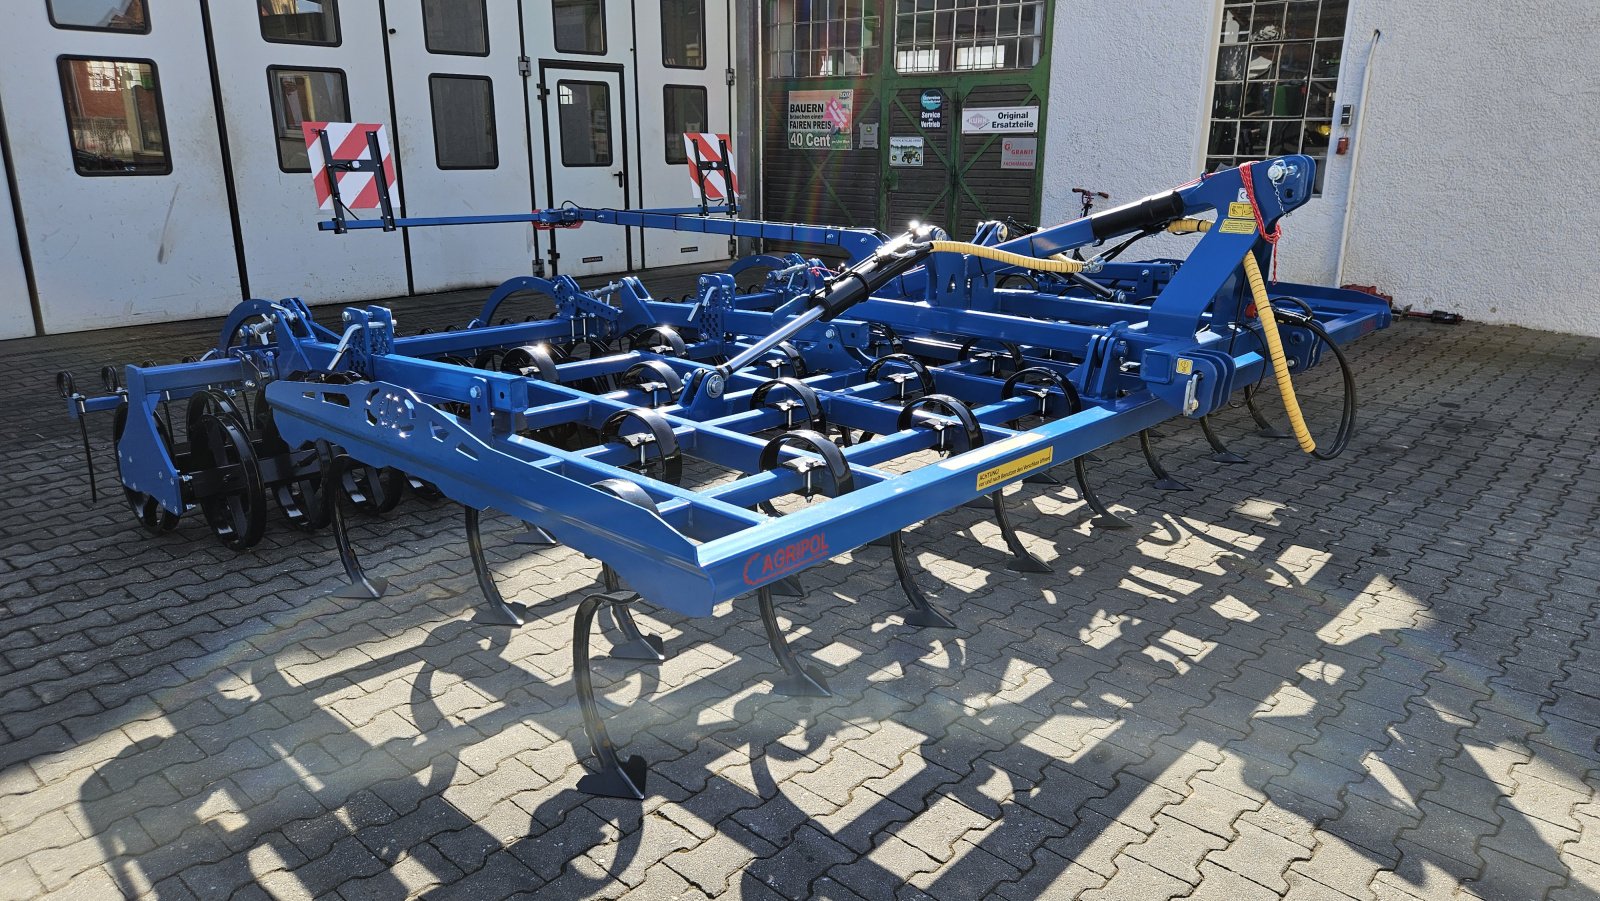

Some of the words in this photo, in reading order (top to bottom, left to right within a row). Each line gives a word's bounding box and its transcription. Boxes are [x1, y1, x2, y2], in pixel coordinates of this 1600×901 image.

[790, 104, 824, 112] BAUERN
[921, 111, 941, 119] Service
[997, 111, 1029, 121] Original
[790, 121, 812, 129] FAIREN
[813, 120, 832, 129] PREIS
[991, 120, 1034, 129] Ersatzteile
[790, 133, 803, 147] 40
[806, 133, 831, 147] Cent
[762, 532, 829, 574] AGRIPOL
